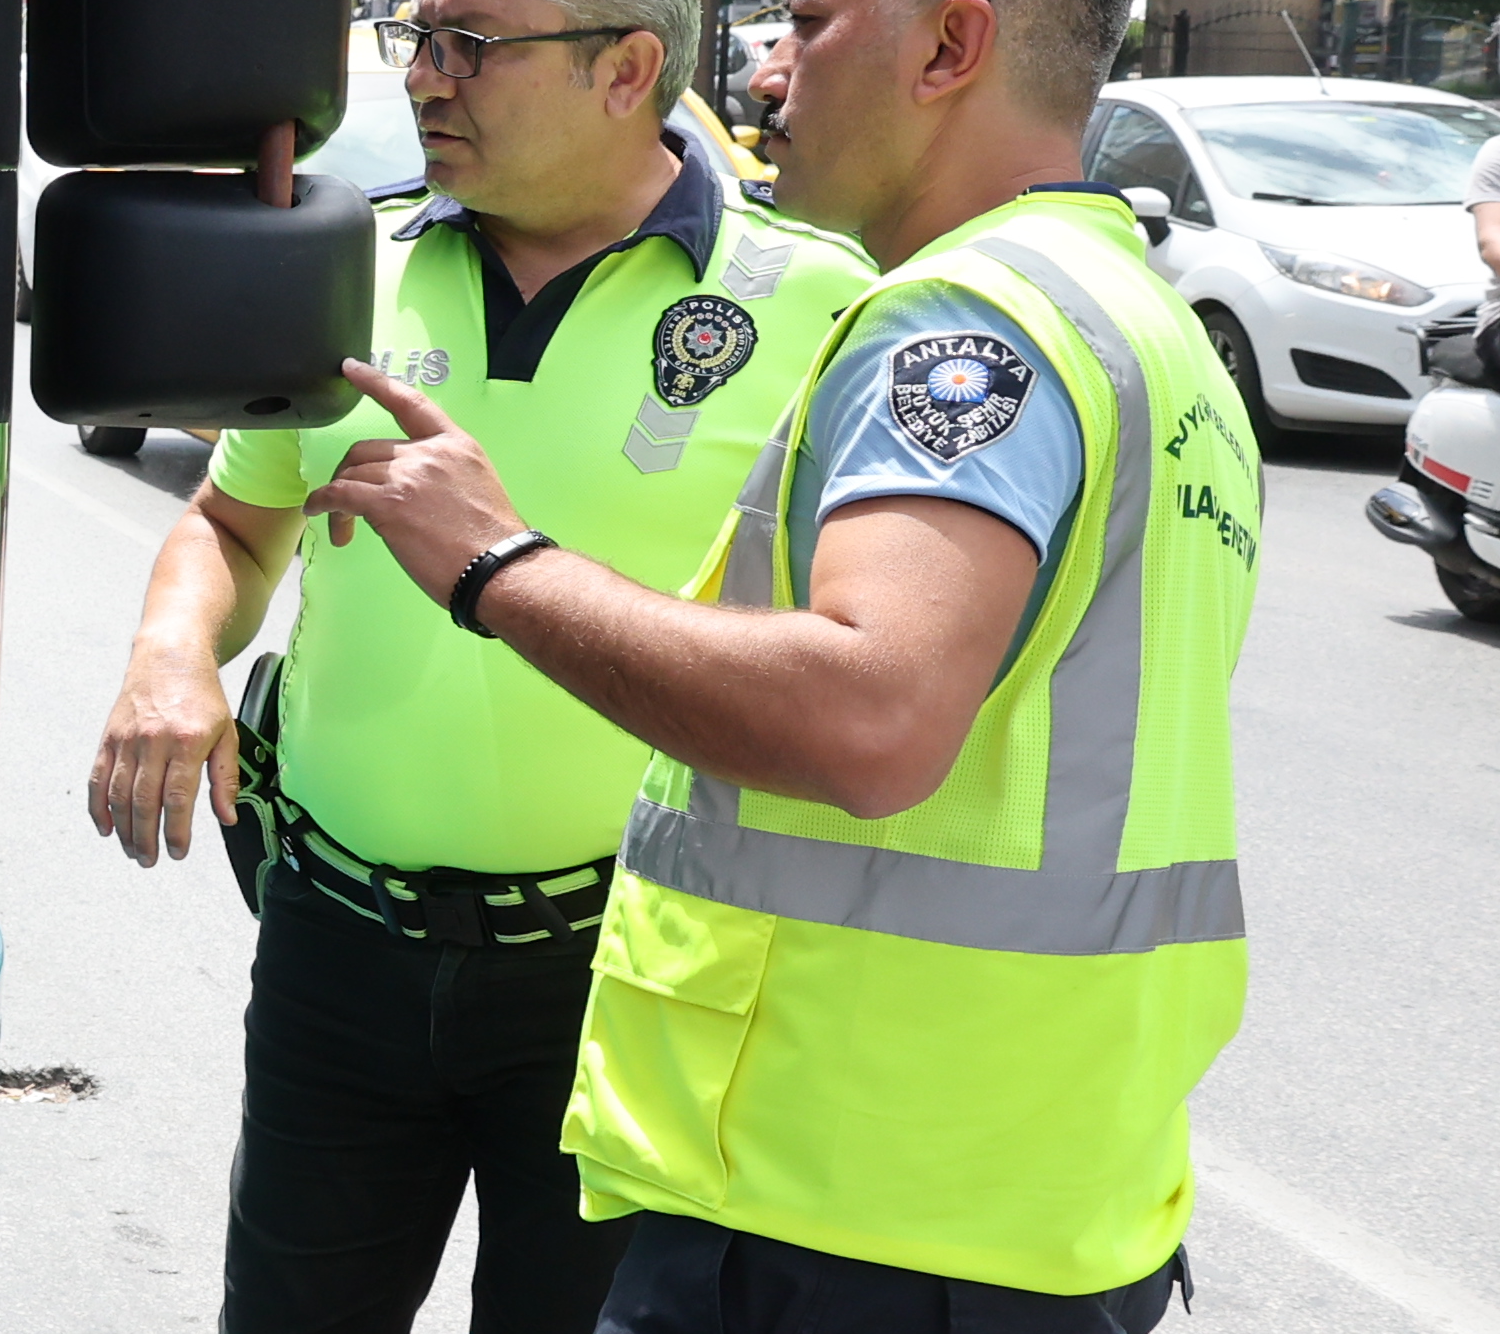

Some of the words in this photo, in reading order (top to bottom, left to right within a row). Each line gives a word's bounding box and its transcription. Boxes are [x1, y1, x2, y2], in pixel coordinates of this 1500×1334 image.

[688, 300, 744, 324] POLİS
[901, 336, 1028, 383] ANTALYA
[894, 383, 947, 453] BELEDİYE
